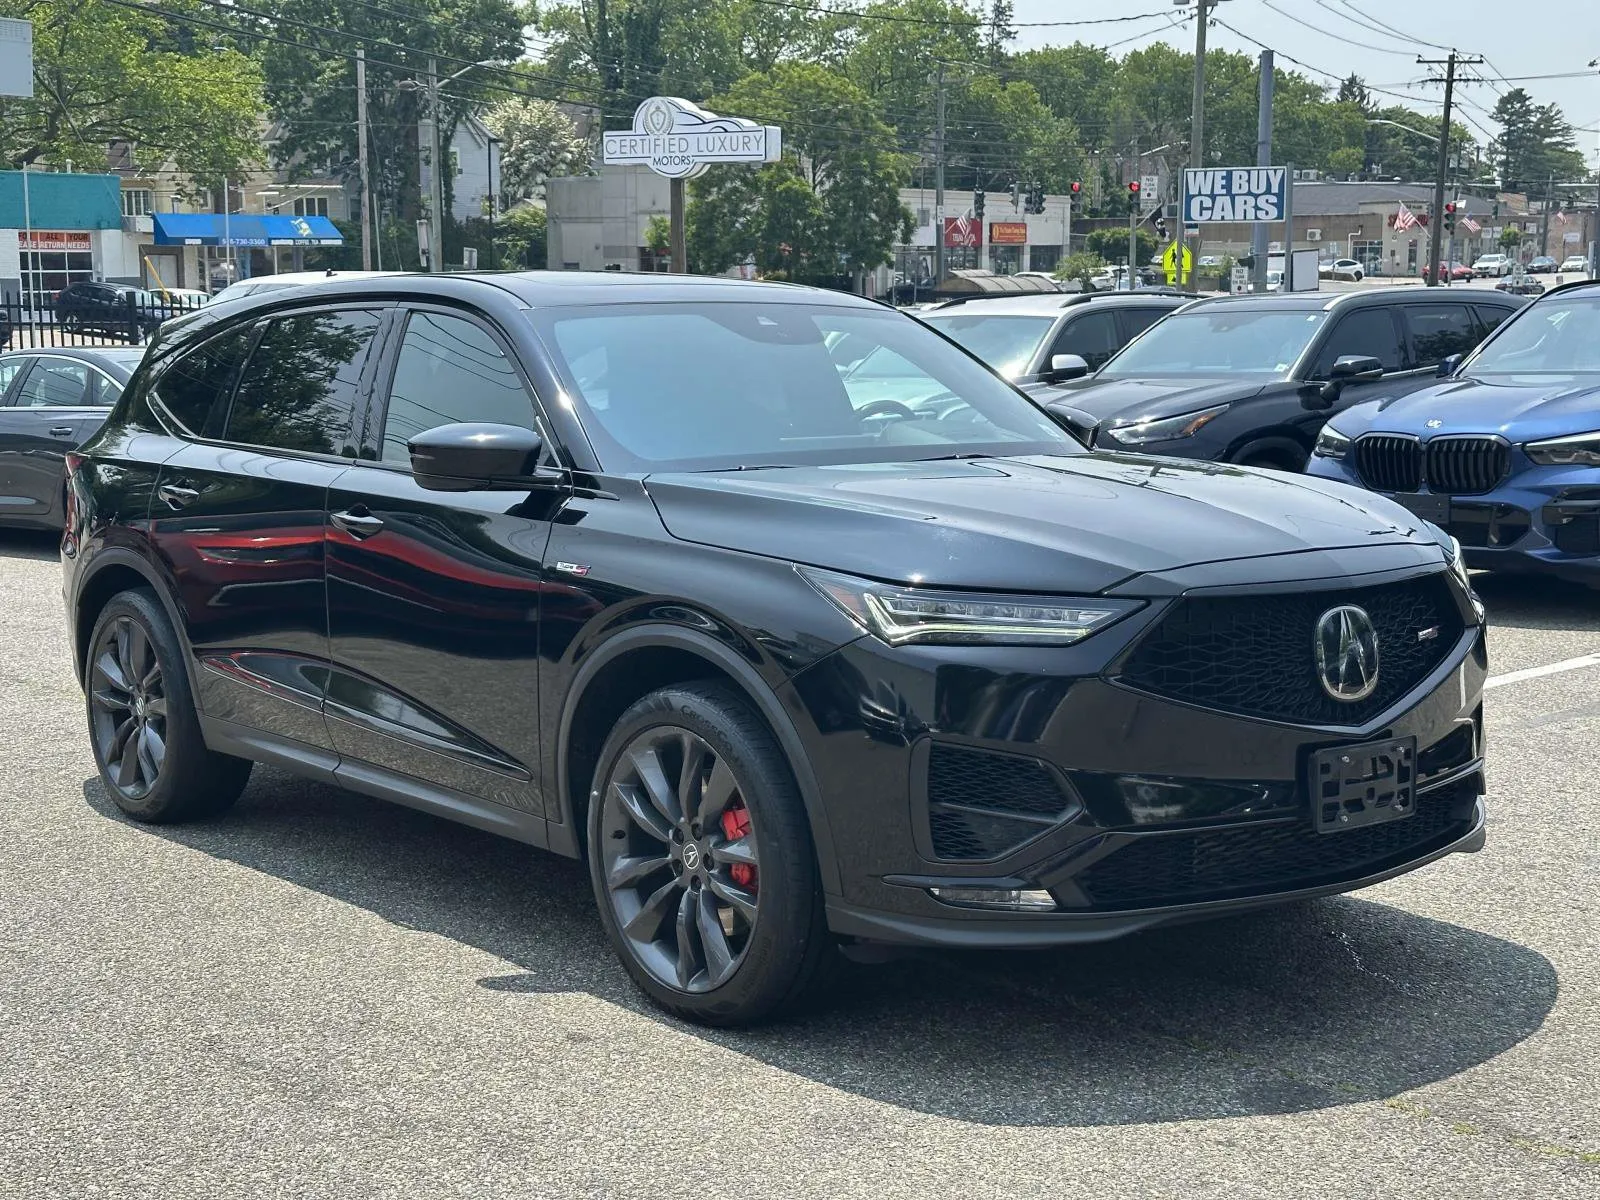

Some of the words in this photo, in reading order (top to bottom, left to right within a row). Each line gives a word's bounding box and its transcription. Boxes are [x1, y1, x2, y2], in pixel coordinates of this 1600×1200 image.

[605, 138, 689, 155] CERTIFIED
[697, 135, 763, 152] LUXURY
[653, 155, 691, 166] MOTORS
[1187, 170, 1227, 195] WE
[1231, 169, 1284, 194] BUY
[1190, 194, 1278, 220] CARS
[46, 232, 59, 240] ALL
[39, 241, 65, 249] RETURN
[67, 241, 90, 249] NEEDS
